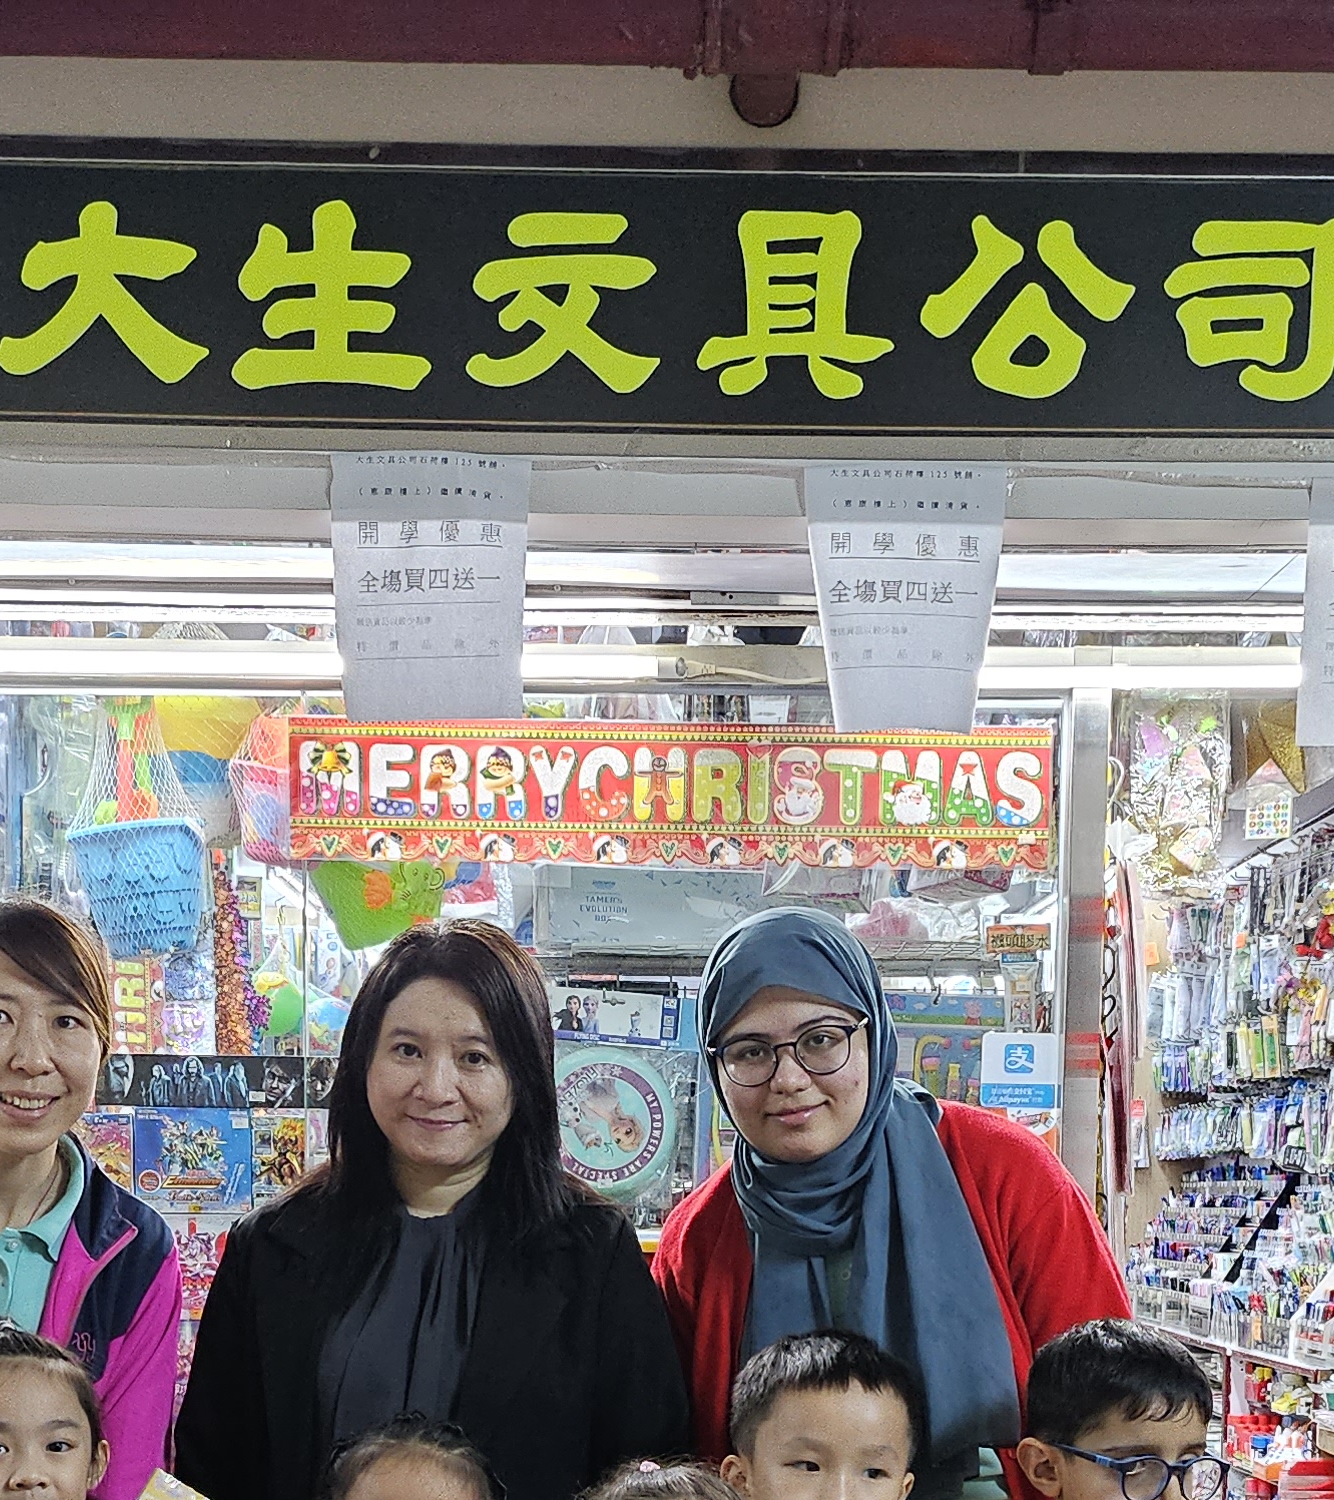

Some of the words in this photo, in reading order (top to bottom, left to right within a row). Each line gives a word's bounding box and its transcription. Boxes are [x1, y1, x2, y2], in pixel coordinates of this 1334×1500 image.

[358, 520, 502, 545] 開學優惠
[830, 532, 980, 557] 開學優惠
[643, 1114, 662, 1159] POWERS
[571, 1162, 619, 1180] SPECIAL
[625, 1160, 643, 1177] ARE
